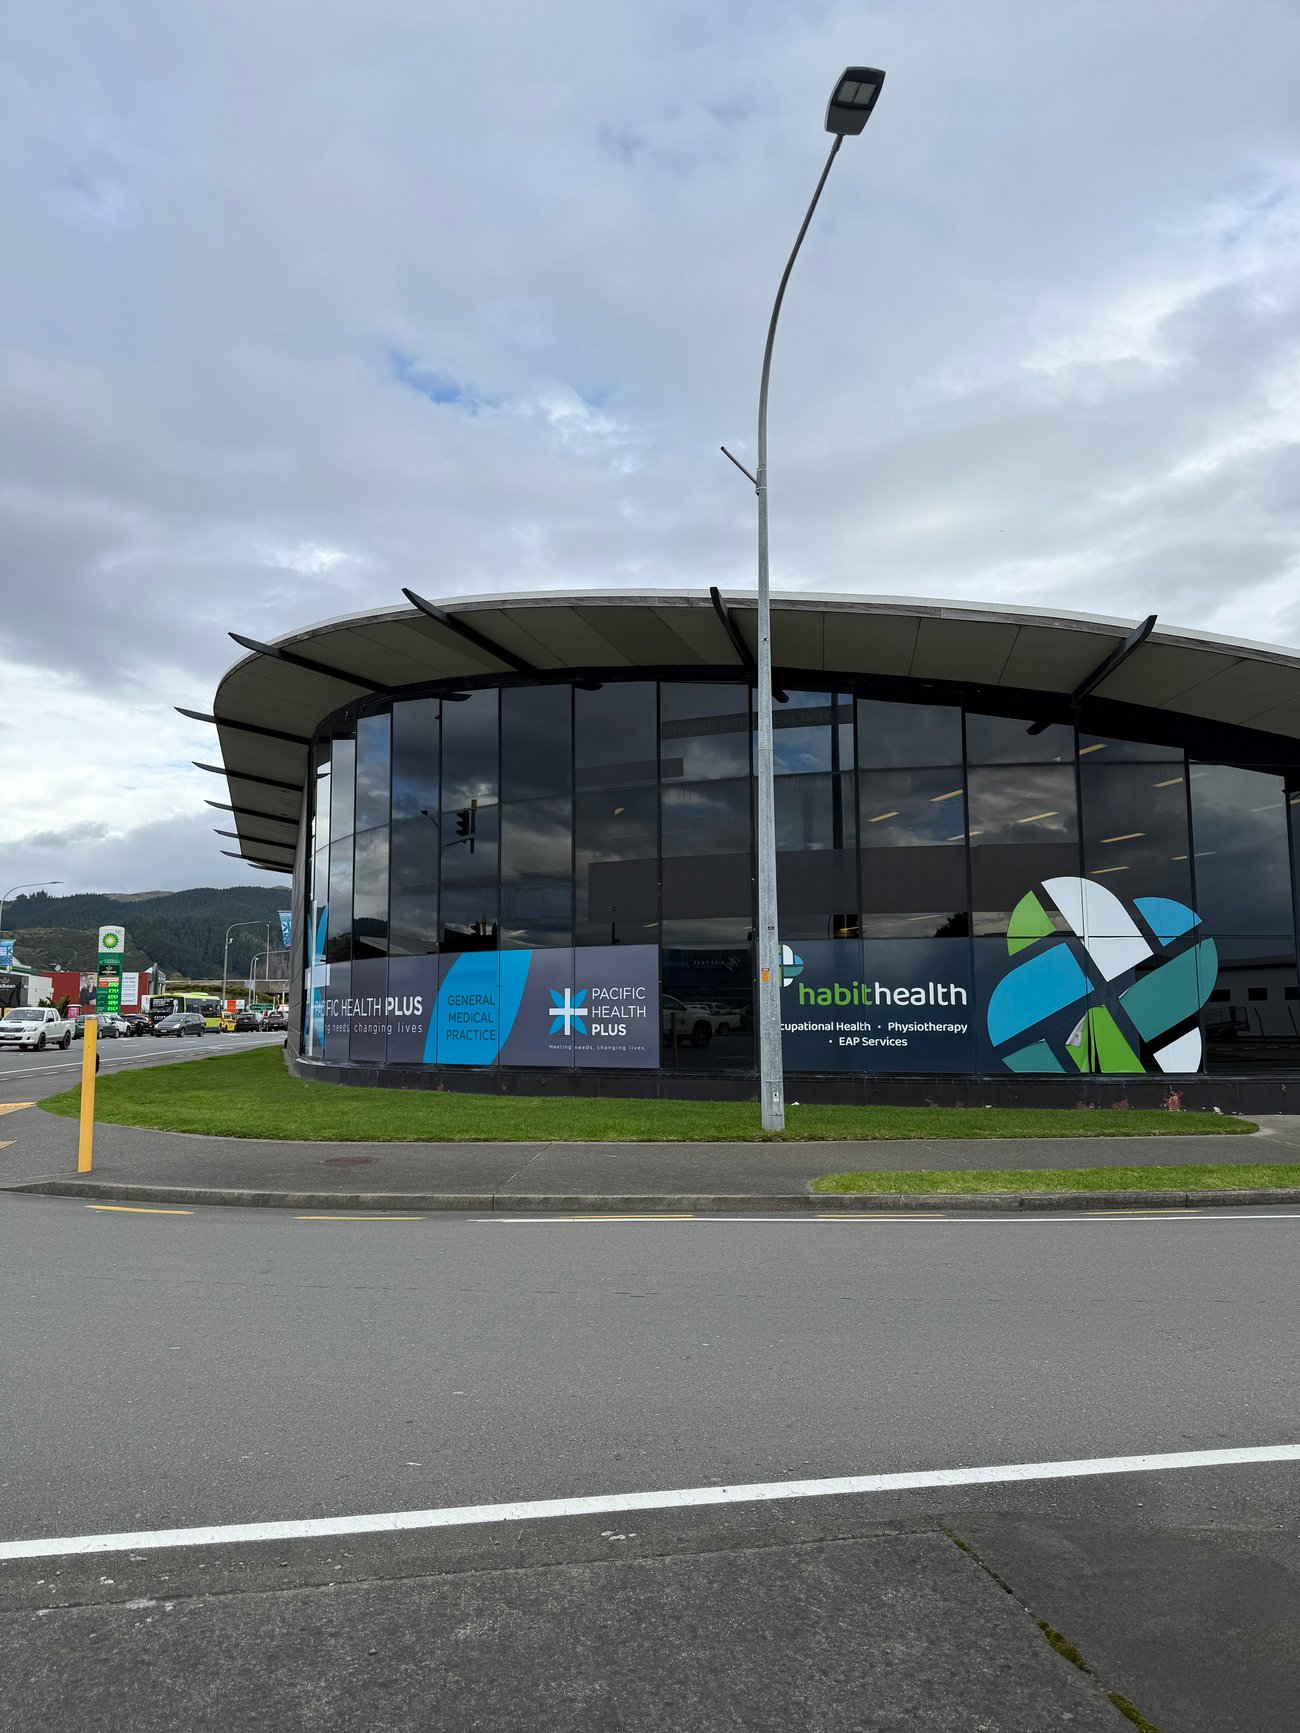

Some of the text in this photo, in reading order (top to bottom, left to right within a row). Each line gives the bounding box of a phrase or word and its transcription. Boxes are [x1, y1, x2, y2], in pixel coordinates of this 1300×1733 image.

[447, 994, 496, 1006] GENERAL
[592, 987, 646, 1000] PACIFIC
[799, 981, 967, 1006] habithealth
[341, 997, 382, 1017] HEALTH
[385, 995, 423, 1016] PLUS
[592, 1005, 646, 1018] HEALTH
[448, 1011, 494, 1024] MEDICAL
[354, 1021, 392, 1035] changing
[397, 1021, 423, 1033] lives
[592, 1023, 627, 1036] PLUS
[781, 1021, 968, 1034] cupational Health Physiotherapy
[446, 1029, 496, 1041] PRACTICE
[839, 1036, 908, 1047] EAP Services
